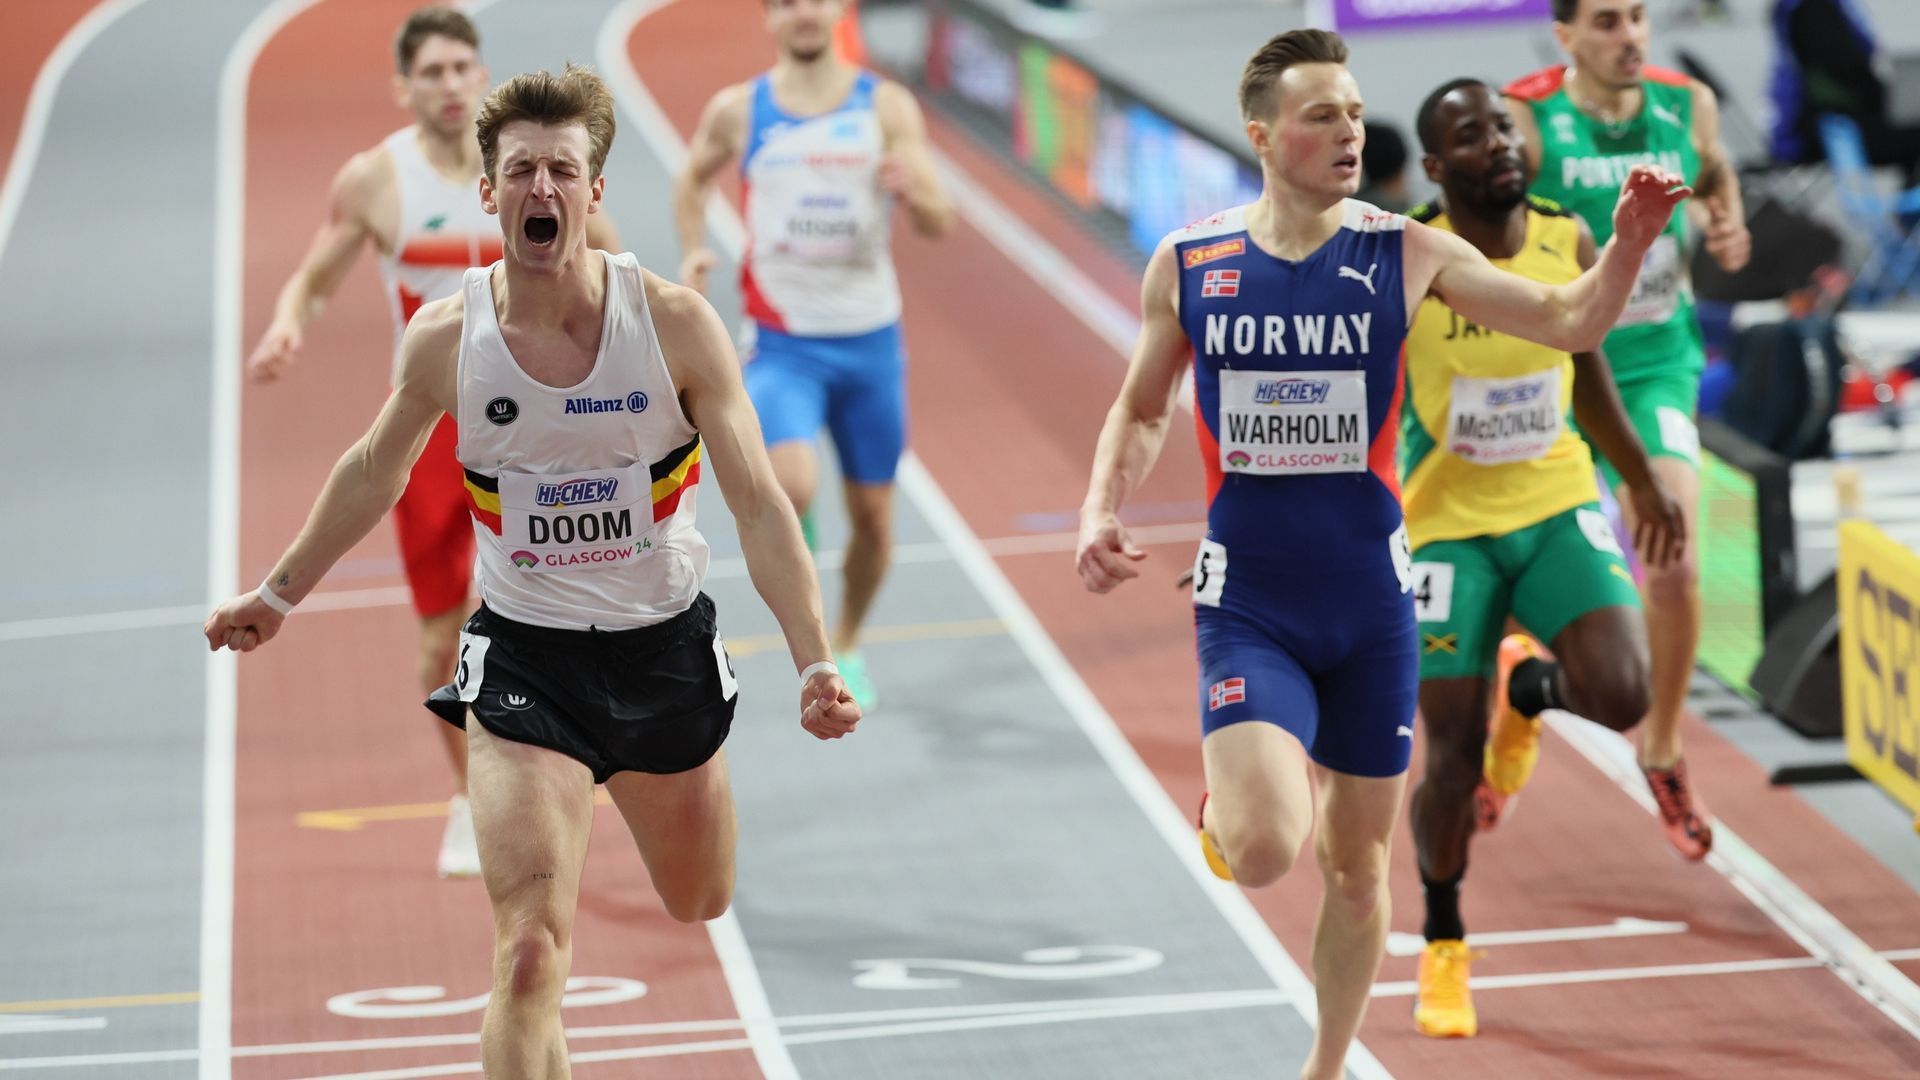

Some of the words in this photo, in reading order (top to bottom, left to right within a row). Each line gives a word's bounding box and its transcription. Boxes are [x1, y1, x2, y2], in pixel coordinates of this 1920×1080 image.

[1205, 312, 1372, 355] NORWAY
[565, 397, 624, 415] Allianz
[1254, 379, 1330, 404] HI-CHEW
[1228, 413, 1358, 444] WARHOLM
[1256, 453, 1339, 467] GLASGOW
[1342, 452, 1360, 464] 24
[536, 477, 618, 506] HI-CHEW
[528, 508, 632, 545] DOOM
[545, 546, 632, 567] GLASGOW
[635, 537, 652, 554] 24
[1413, 573, 1432, 609] 4
[458, 643, 471, 691] 6
[1858, 567, 1920, 782] SE
